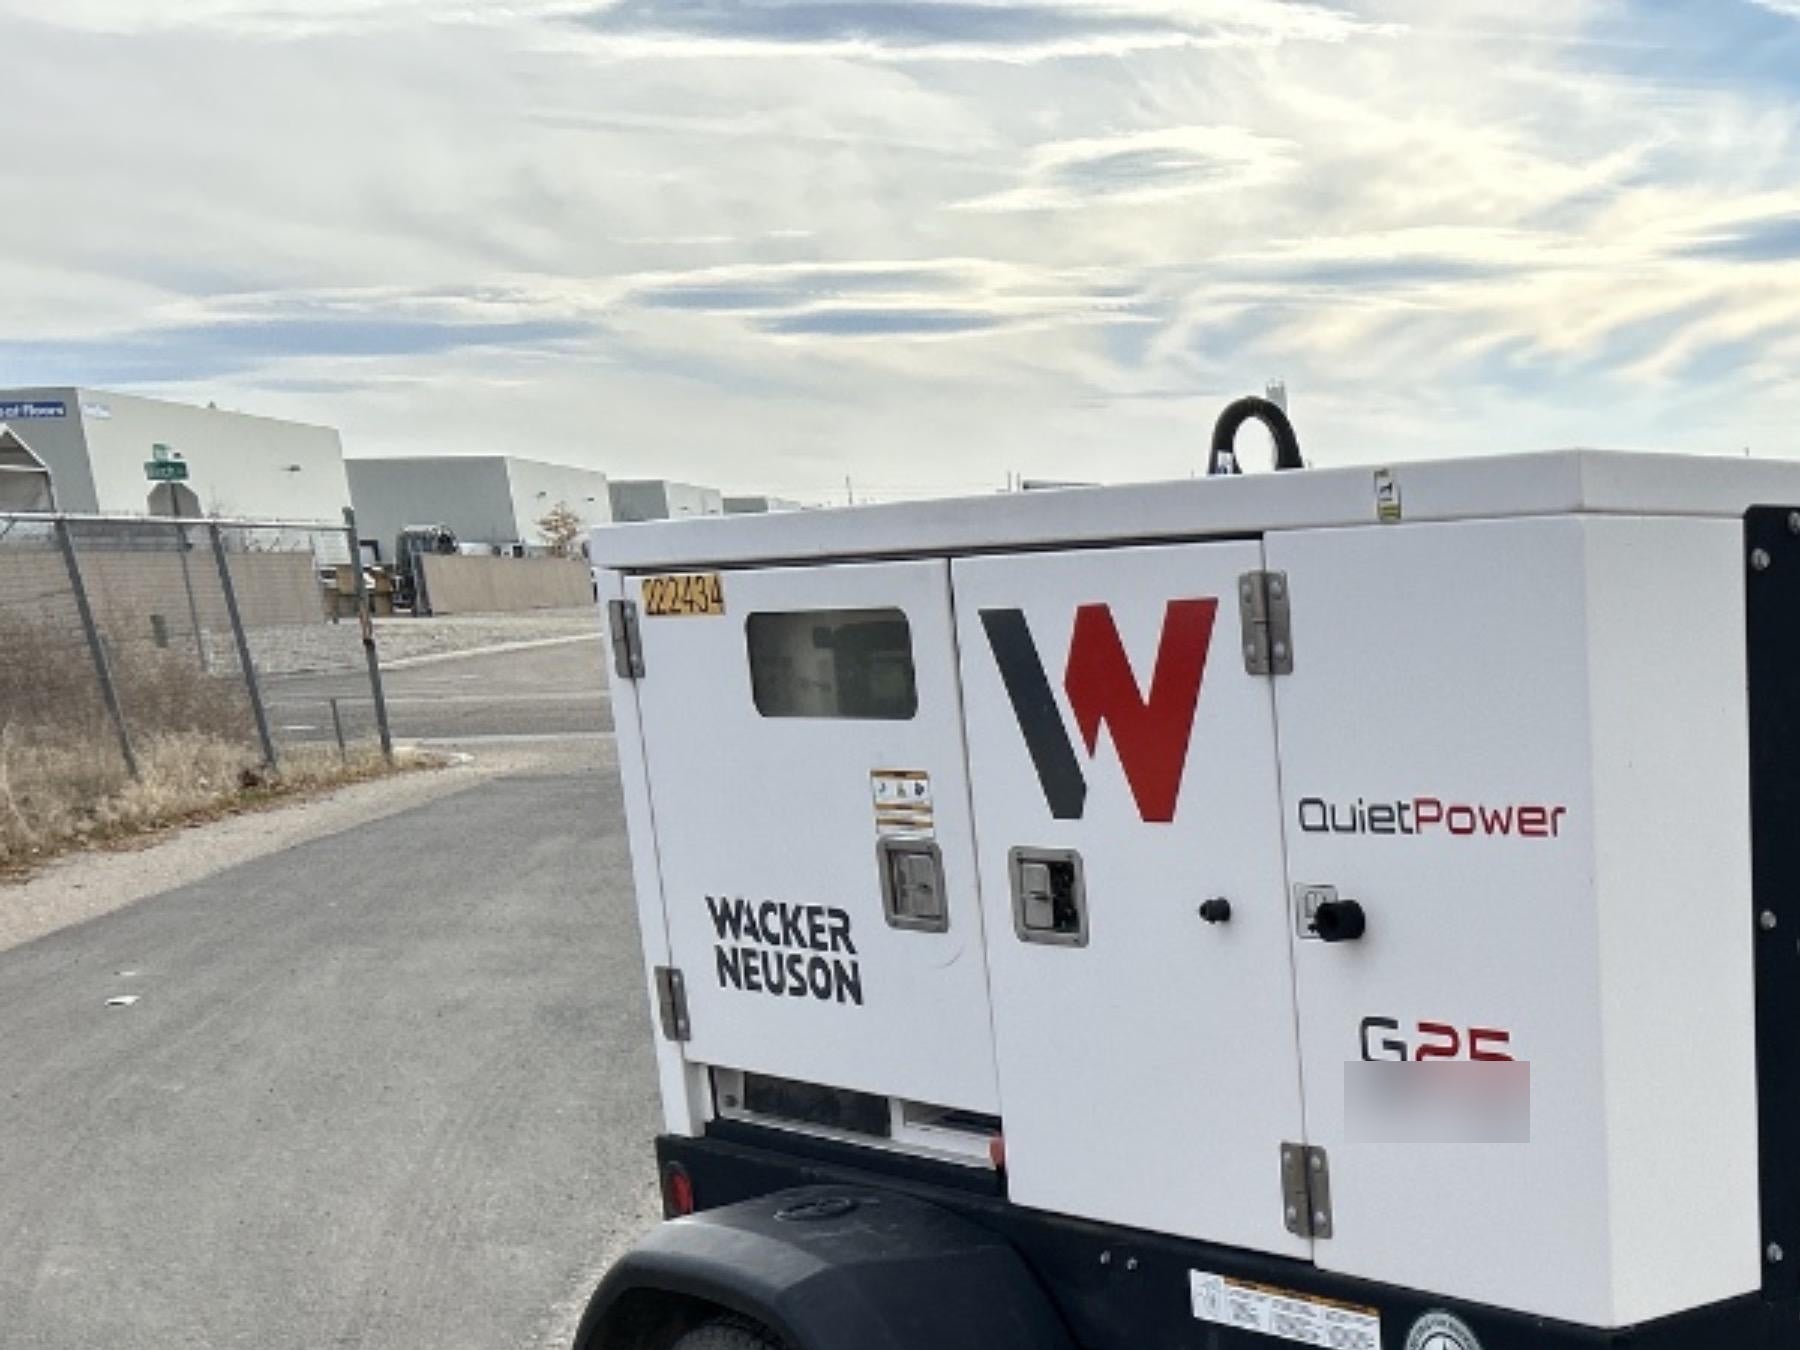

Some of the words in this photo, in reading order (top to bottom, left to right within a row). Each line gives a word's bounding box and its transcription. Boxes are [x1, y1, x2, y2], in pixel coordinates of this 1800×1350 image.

[641, 575, 724, 615] 222434
[977, 596, 1219, 823] W
[1298, 797, 1567, 838] QuietPower
[704, 895, 858, 955] WACKER
[714, 943, 864, 1006] NEUSON
[1360, 1016, 1515, 1062] G25
